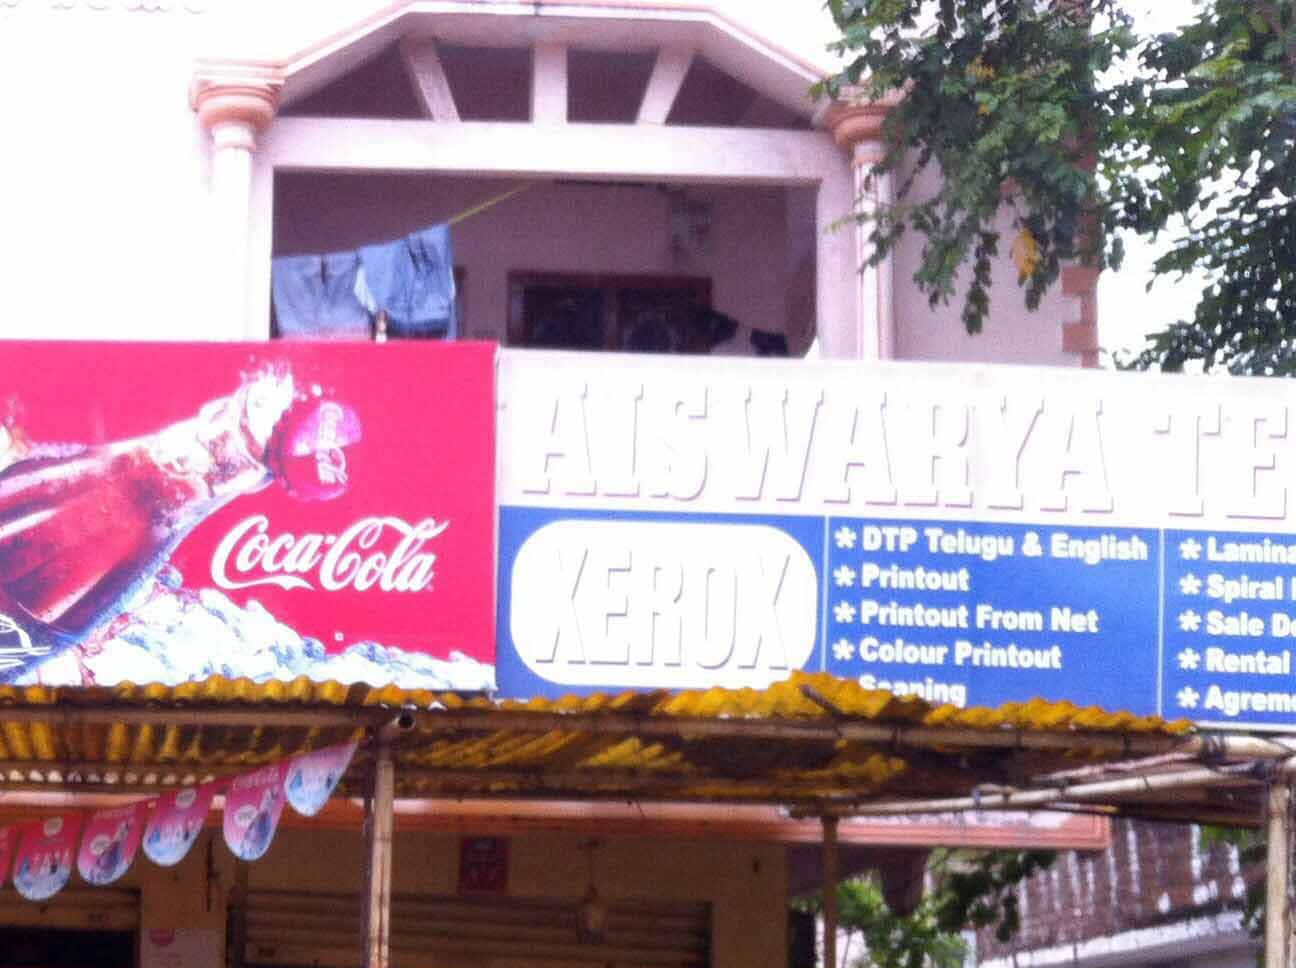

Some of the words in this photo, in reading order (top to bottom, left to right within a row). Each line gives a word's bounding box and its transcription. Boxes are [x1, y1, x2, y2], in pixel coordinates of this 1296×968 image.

[522, 383, 1115, 513] AISWARYA
[210, 514, 449, 593] Coca-Cola
[862, 525, 918, 553] DTP
[924, 528, 1014, 561] Telugu
[1021, 531, 1042, 557] &
[1050, 532, 1148, 565] English
[860, 563, 970, 592] Printout
[1206, 572, 1285, 604] Spiral
[535, 548, 791, 671] XEROX
[860, 601, 969, 629] Printout
[975, 603, 1043, 631] From
[1050, 606, 1100, 634] Net
[1205, 609, 1265, 637] Sale
[859, 637, 948, 666] Colour
[954, 640, 1062, 670] Printout
[1205, 646, 1291, 675] Rental
